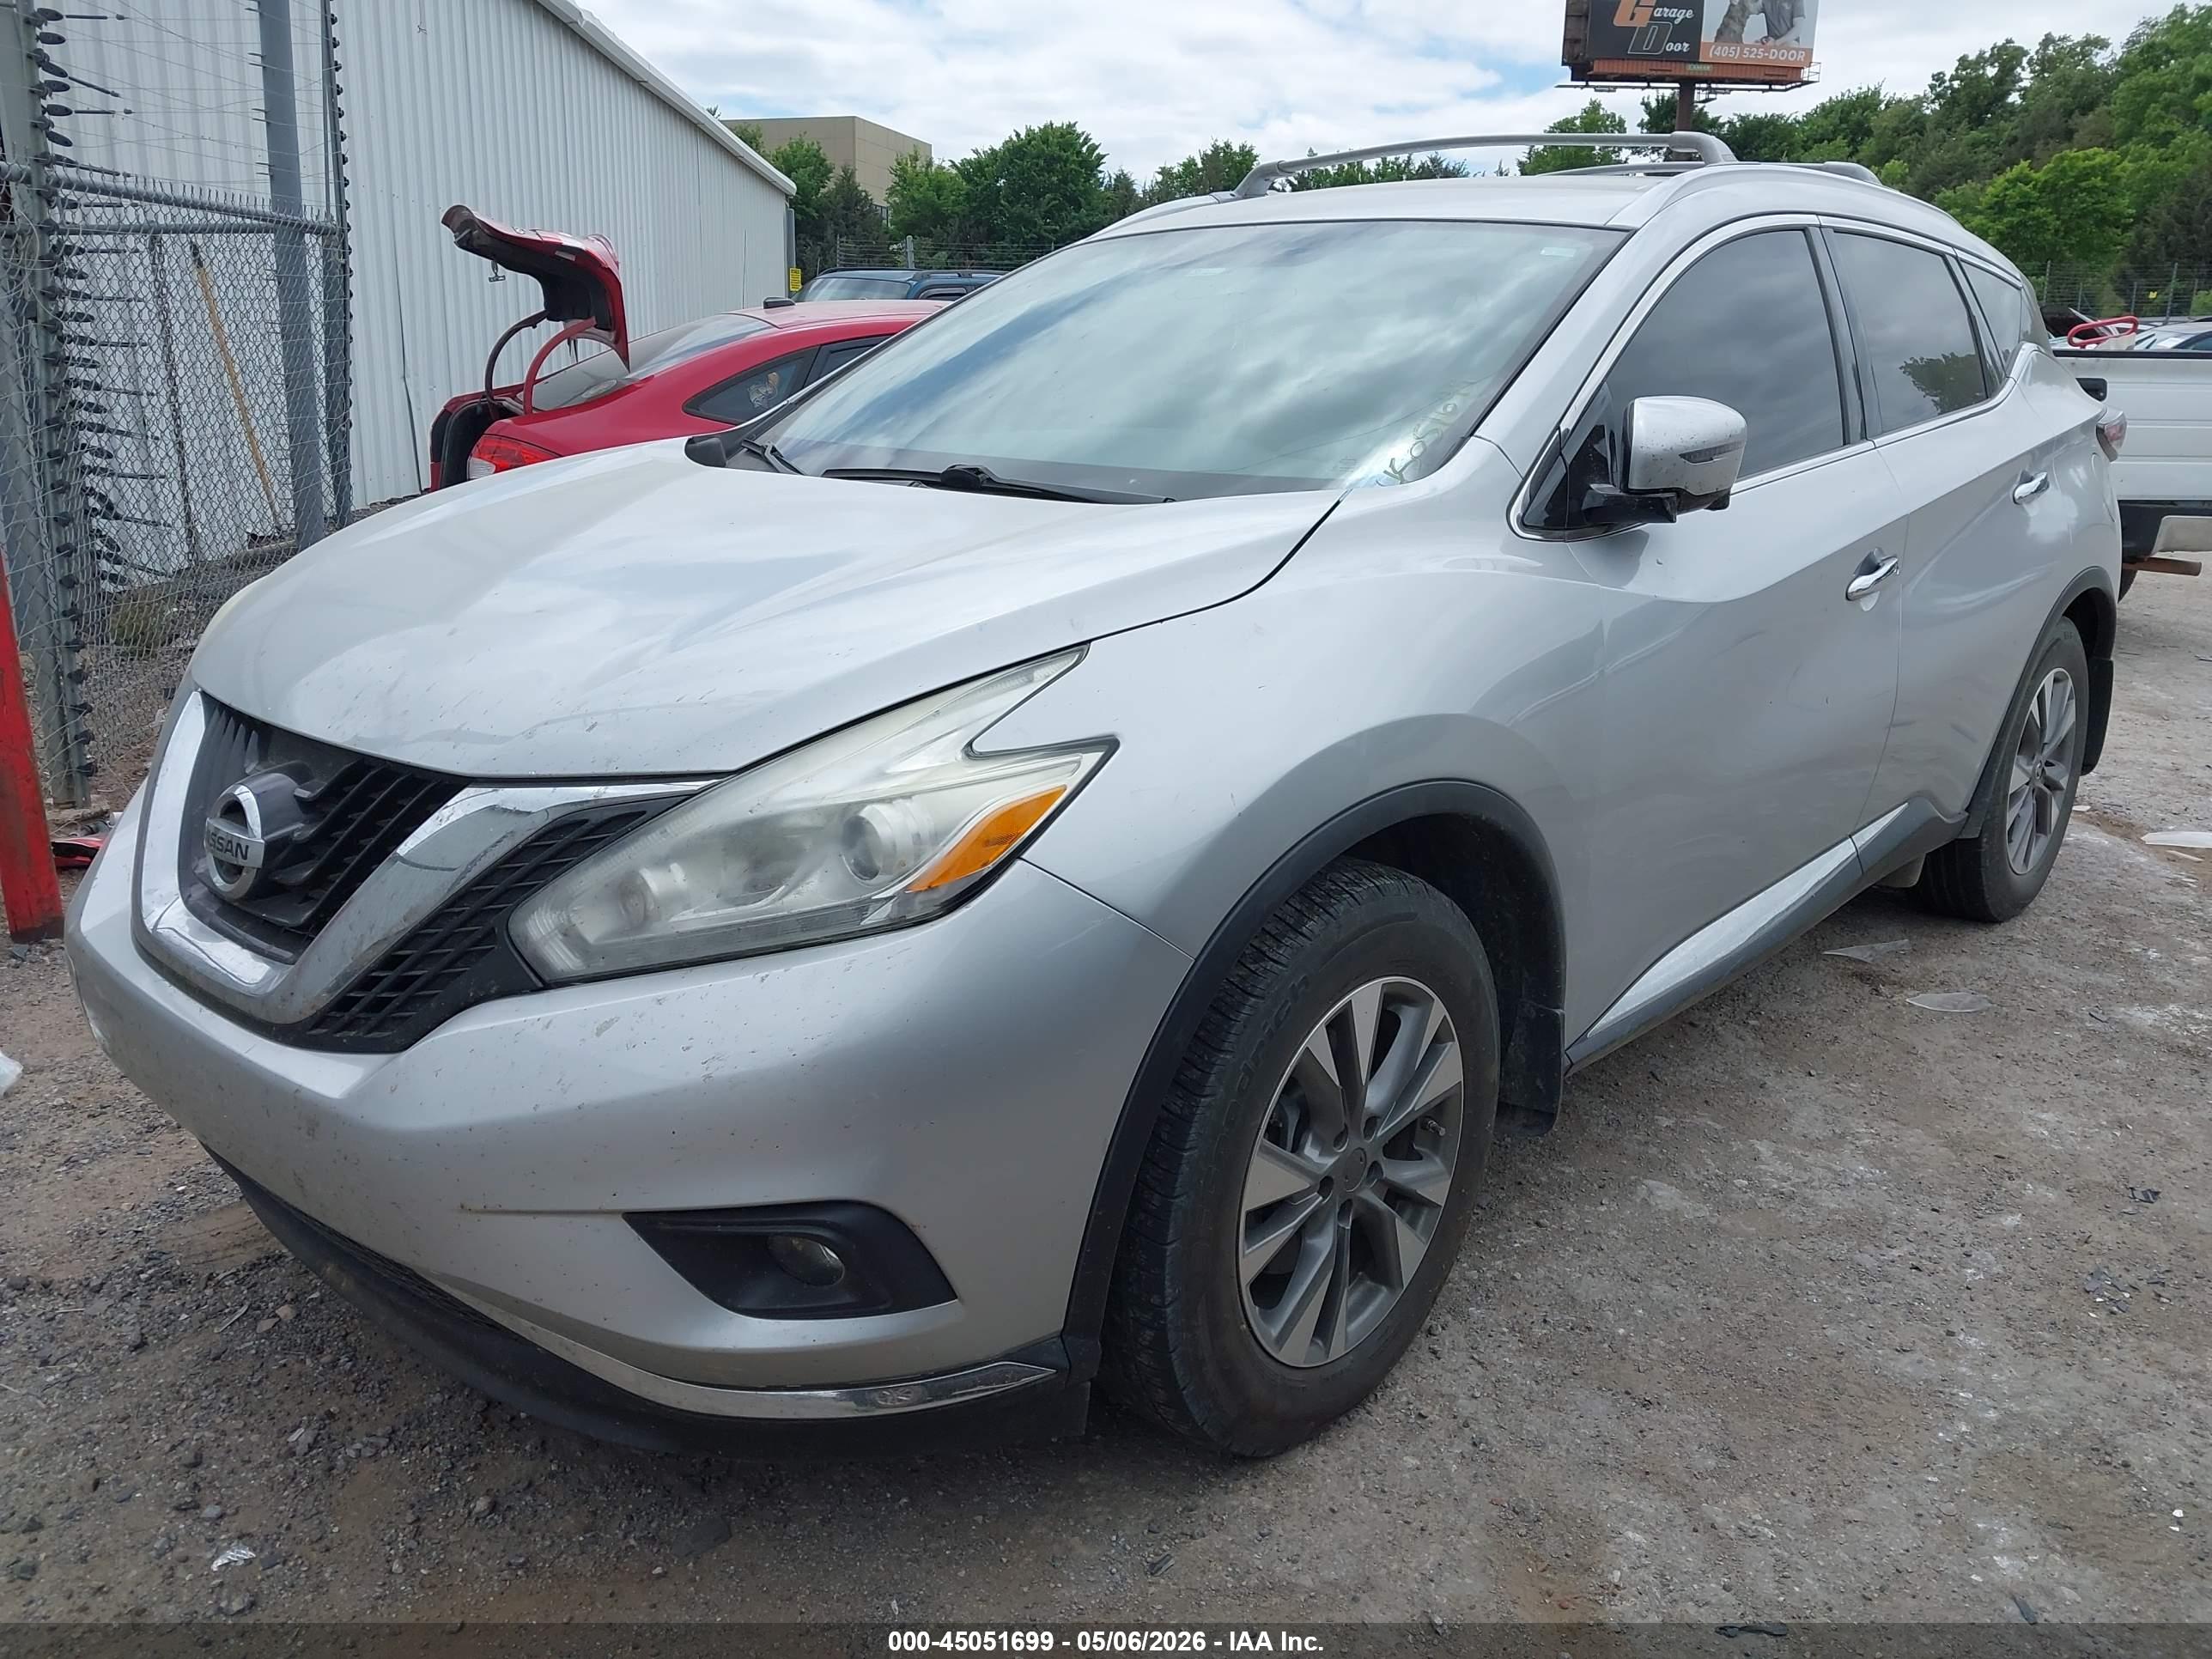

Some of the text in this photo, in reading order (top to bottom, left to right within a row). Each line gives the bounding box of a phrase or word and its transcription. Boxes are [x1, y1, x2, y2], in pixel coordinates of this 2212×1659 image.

[1628, 21, 1690, 54] Door
[1709, 45, 1806, 61] (405) 525-DOOR
